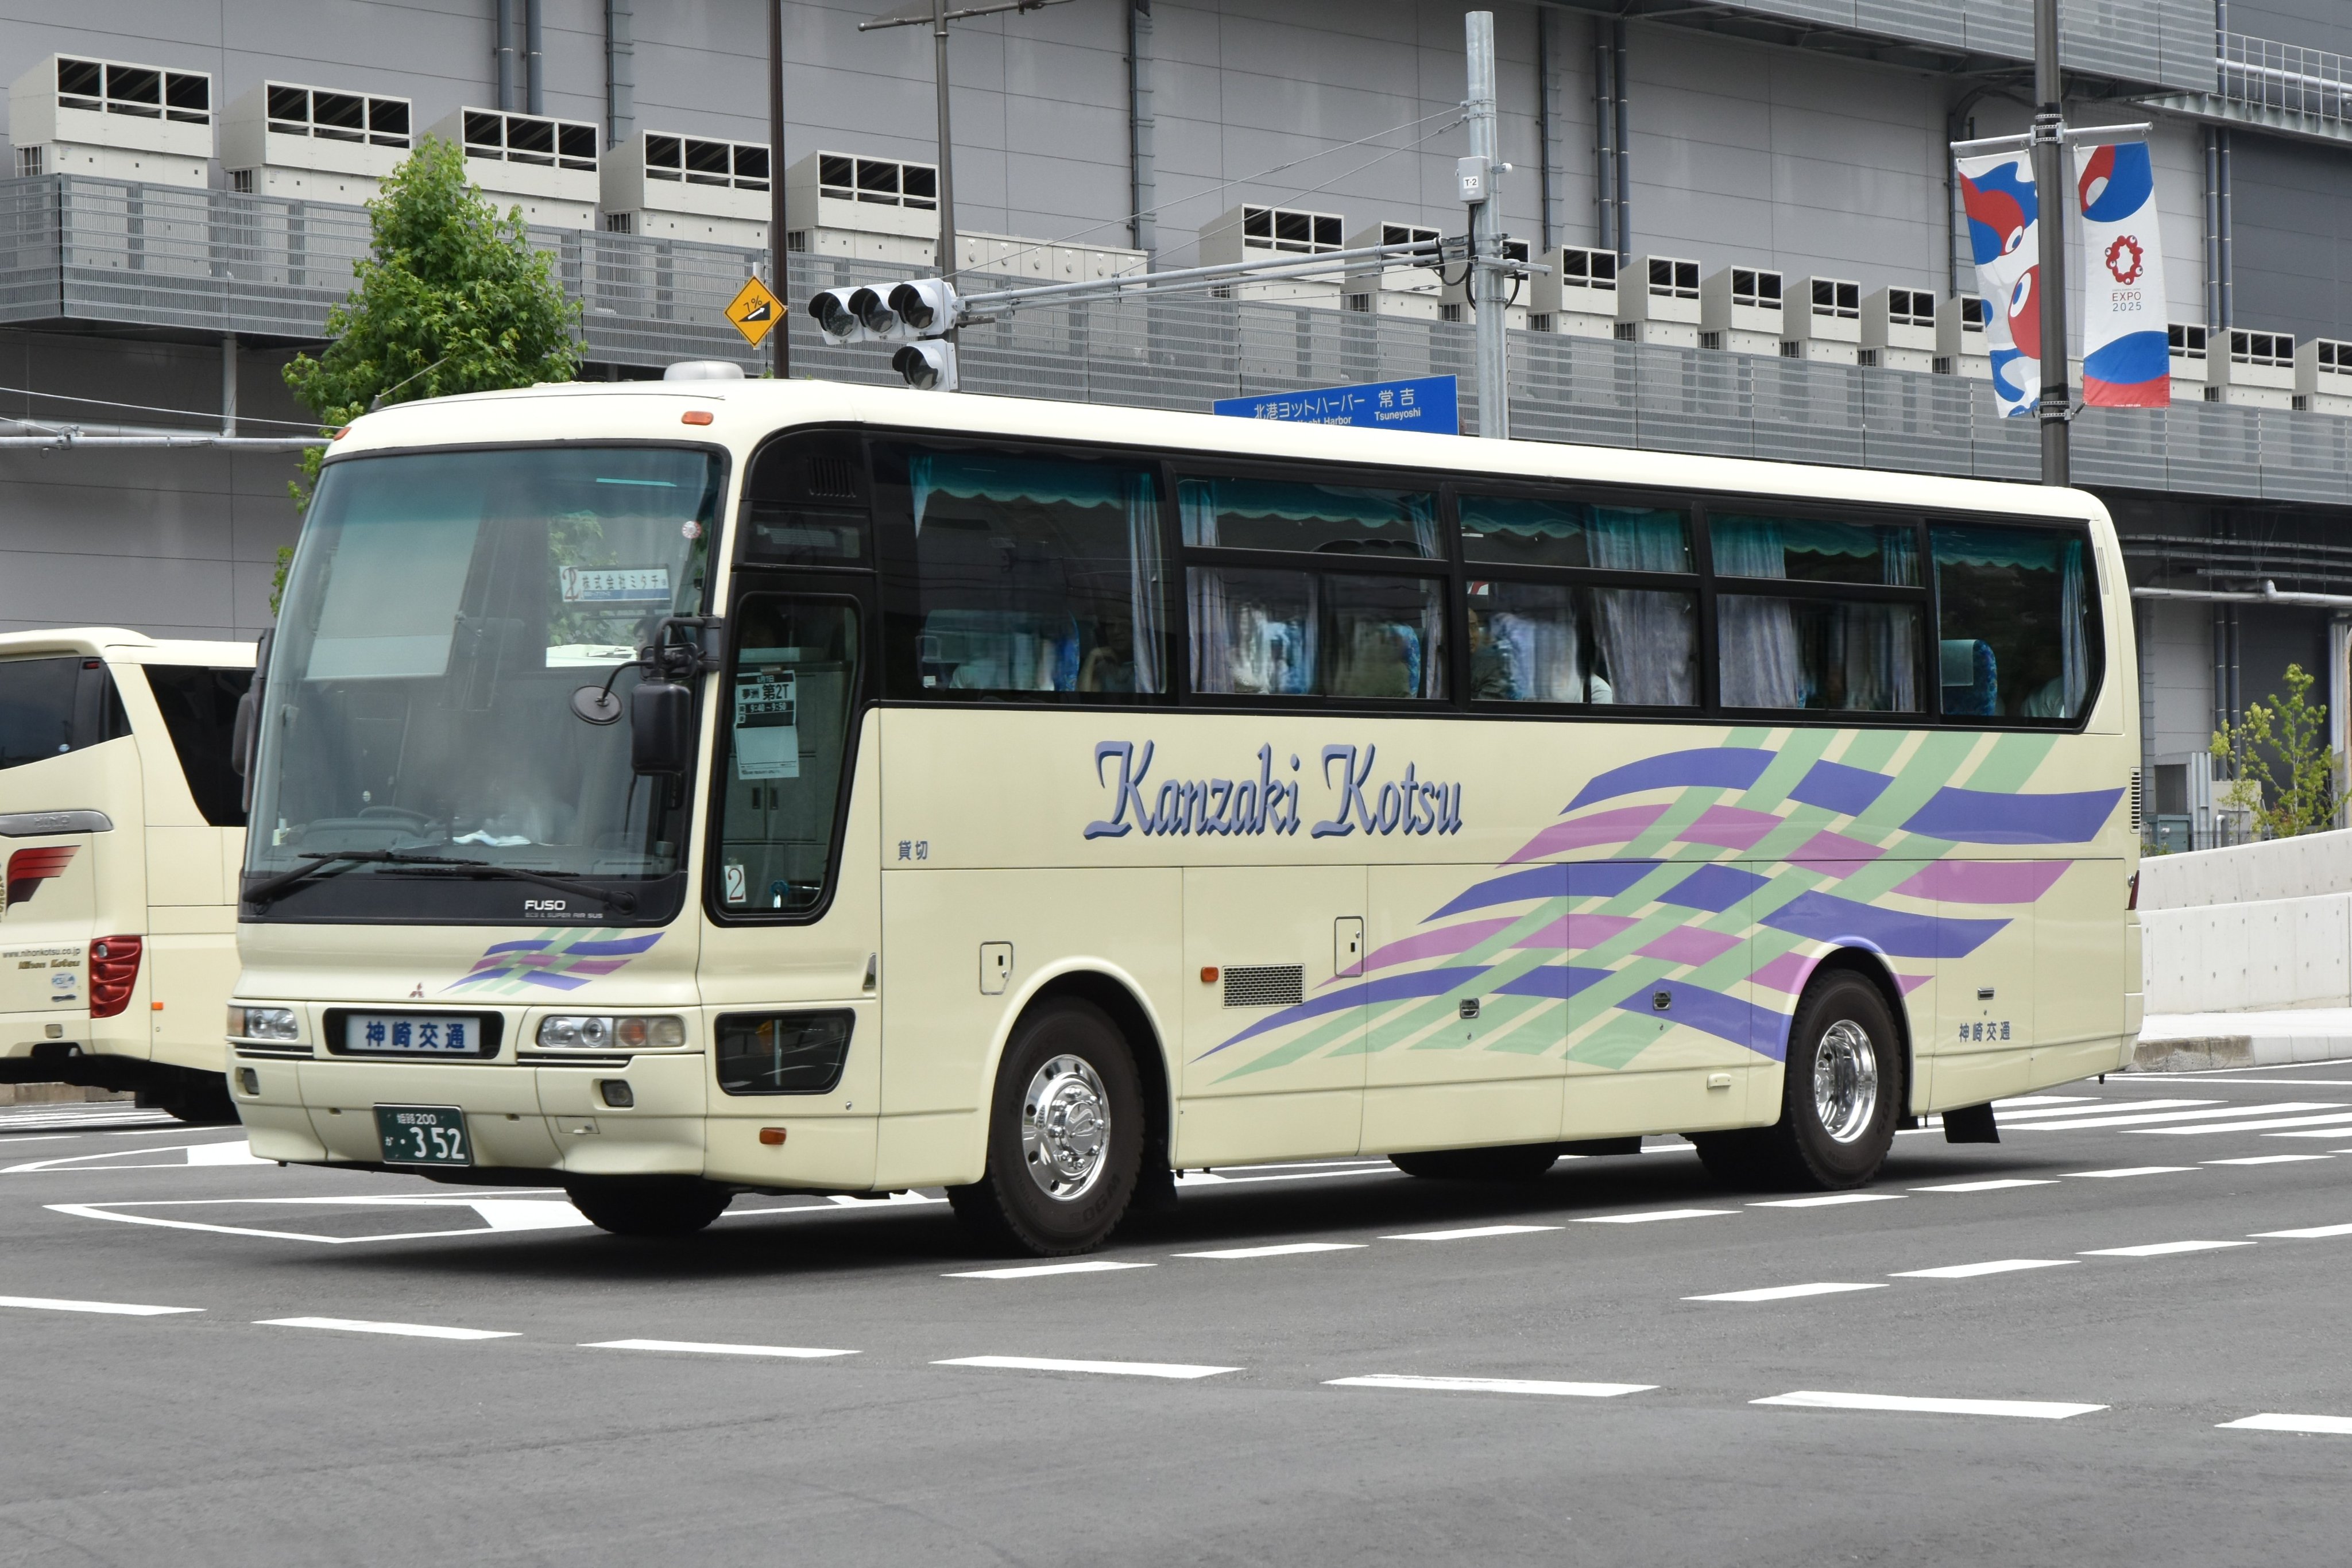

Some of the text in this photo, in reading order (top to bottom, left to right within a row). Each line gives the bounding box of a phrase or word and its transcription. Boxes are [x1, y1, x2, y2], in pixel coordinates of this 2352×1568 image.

[743, 295, 763, 312] 7%
[2112, 291, 2141, 301] EXPO
[2113, 301, 2141, 312] 2025
[1254, 388, 1414, 420] 北港ヨットハーバー 常吉
[1324, 415, 1353, 425] Harbor
[1374, 407, 1421, 421] Tsuneyoshi
[1083, 739, 1463, 841] Kanzaki Kotsu
[898, 840, 927, 861] 貸切
[728, 868, 744, 900] 2
[525, 900, 566, 910] FUSO
[366, 1021, 465, 1049] 神崎交通
[1959, 1021, 2010, 1043] 神崎交通
